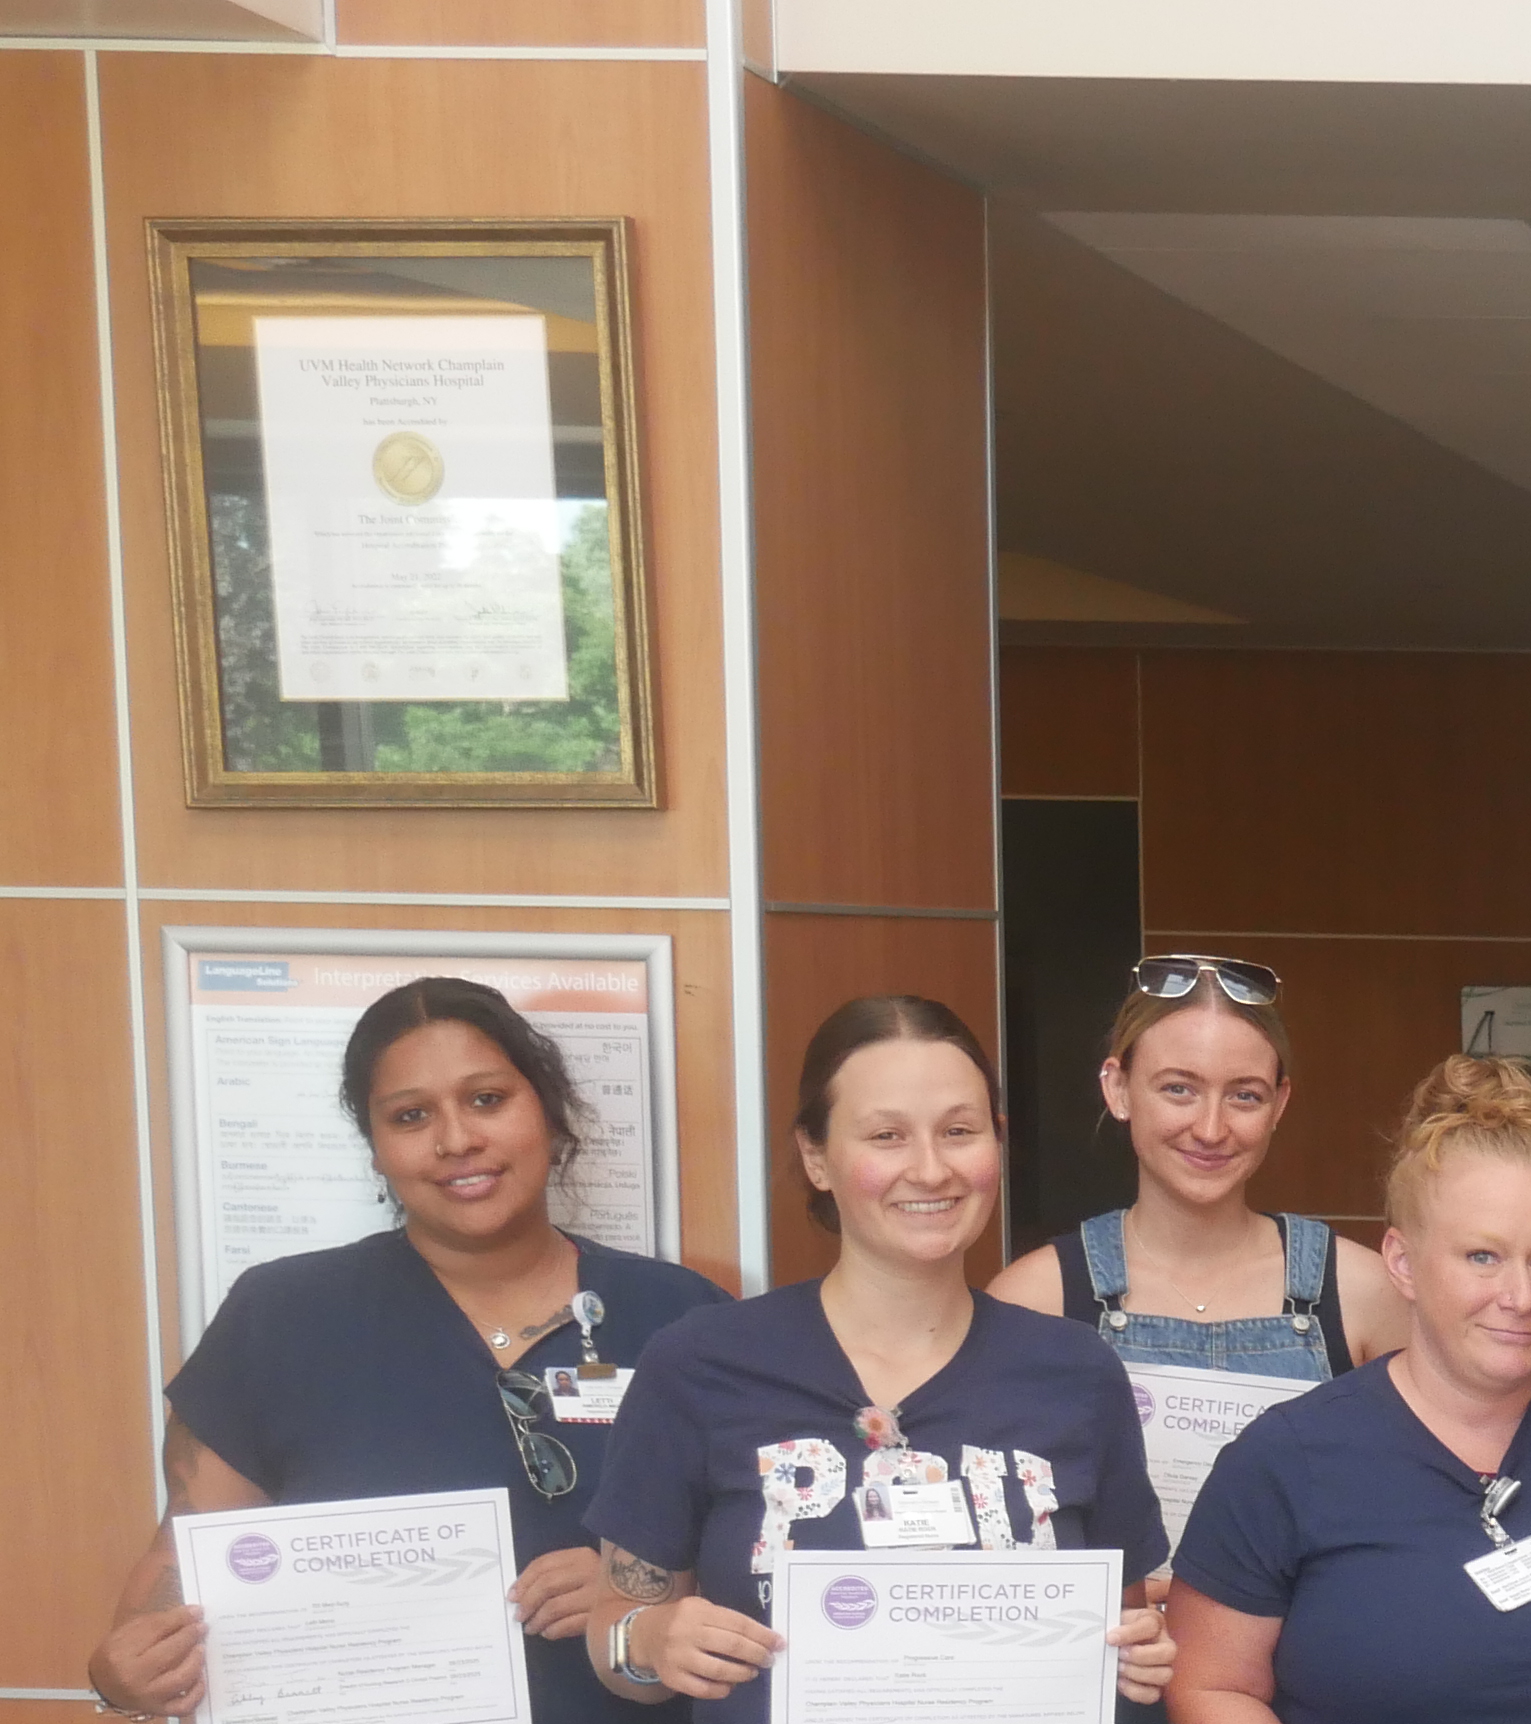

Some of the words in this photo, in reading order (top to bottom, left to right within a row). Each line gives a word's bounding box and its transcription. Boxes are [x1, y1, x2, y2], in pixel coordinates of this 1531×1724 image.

[300, 360, 333, 372] UVM
[339, 359, 378, 372] Health
[382, 359, 434, 372] Network
[438, 359, 504, 373] Champlain
[322, 375, 360, 389] Valley
[365, 375, 430, 389] Physicians
[434, 375, 484, 389] Hospital
[205, 965, 282, 977] LanguageLine
[314, 967, 418, 990] Interpreta
[548, 973, 639, 991] Available
[215, 1035, 264, 1045] American
[267, 1036, 291, 1047] Sign
[217, 1077, 250, 1086] Arabic
[219, 1119, 258, 1130] Bengali
[221, 1161, 267, 1170] Burmese
[609, 1169, 637, 1179] Polski
[223, 1202, 278, 1212] Cantonese
[590, 1210, 639, 1222] Português
[225, 1245, 250, 1255] Farsi
[1165, 1395, 1267, 1418] CERTIFICA
[1163, 1415, 1245, 1436] COMPLE
[290, 1527, 430, 1553] CERTIFICATE
[437, 1523, 466, 1540] OF
[292, 1547, 435, 1574] COMPLETION
[889, 1583, 1036, 1600] CERTIFICATE
[1044, 1583, 1076, 1599] OF
[889, 1605, 1039, 1622] COMPLETION
